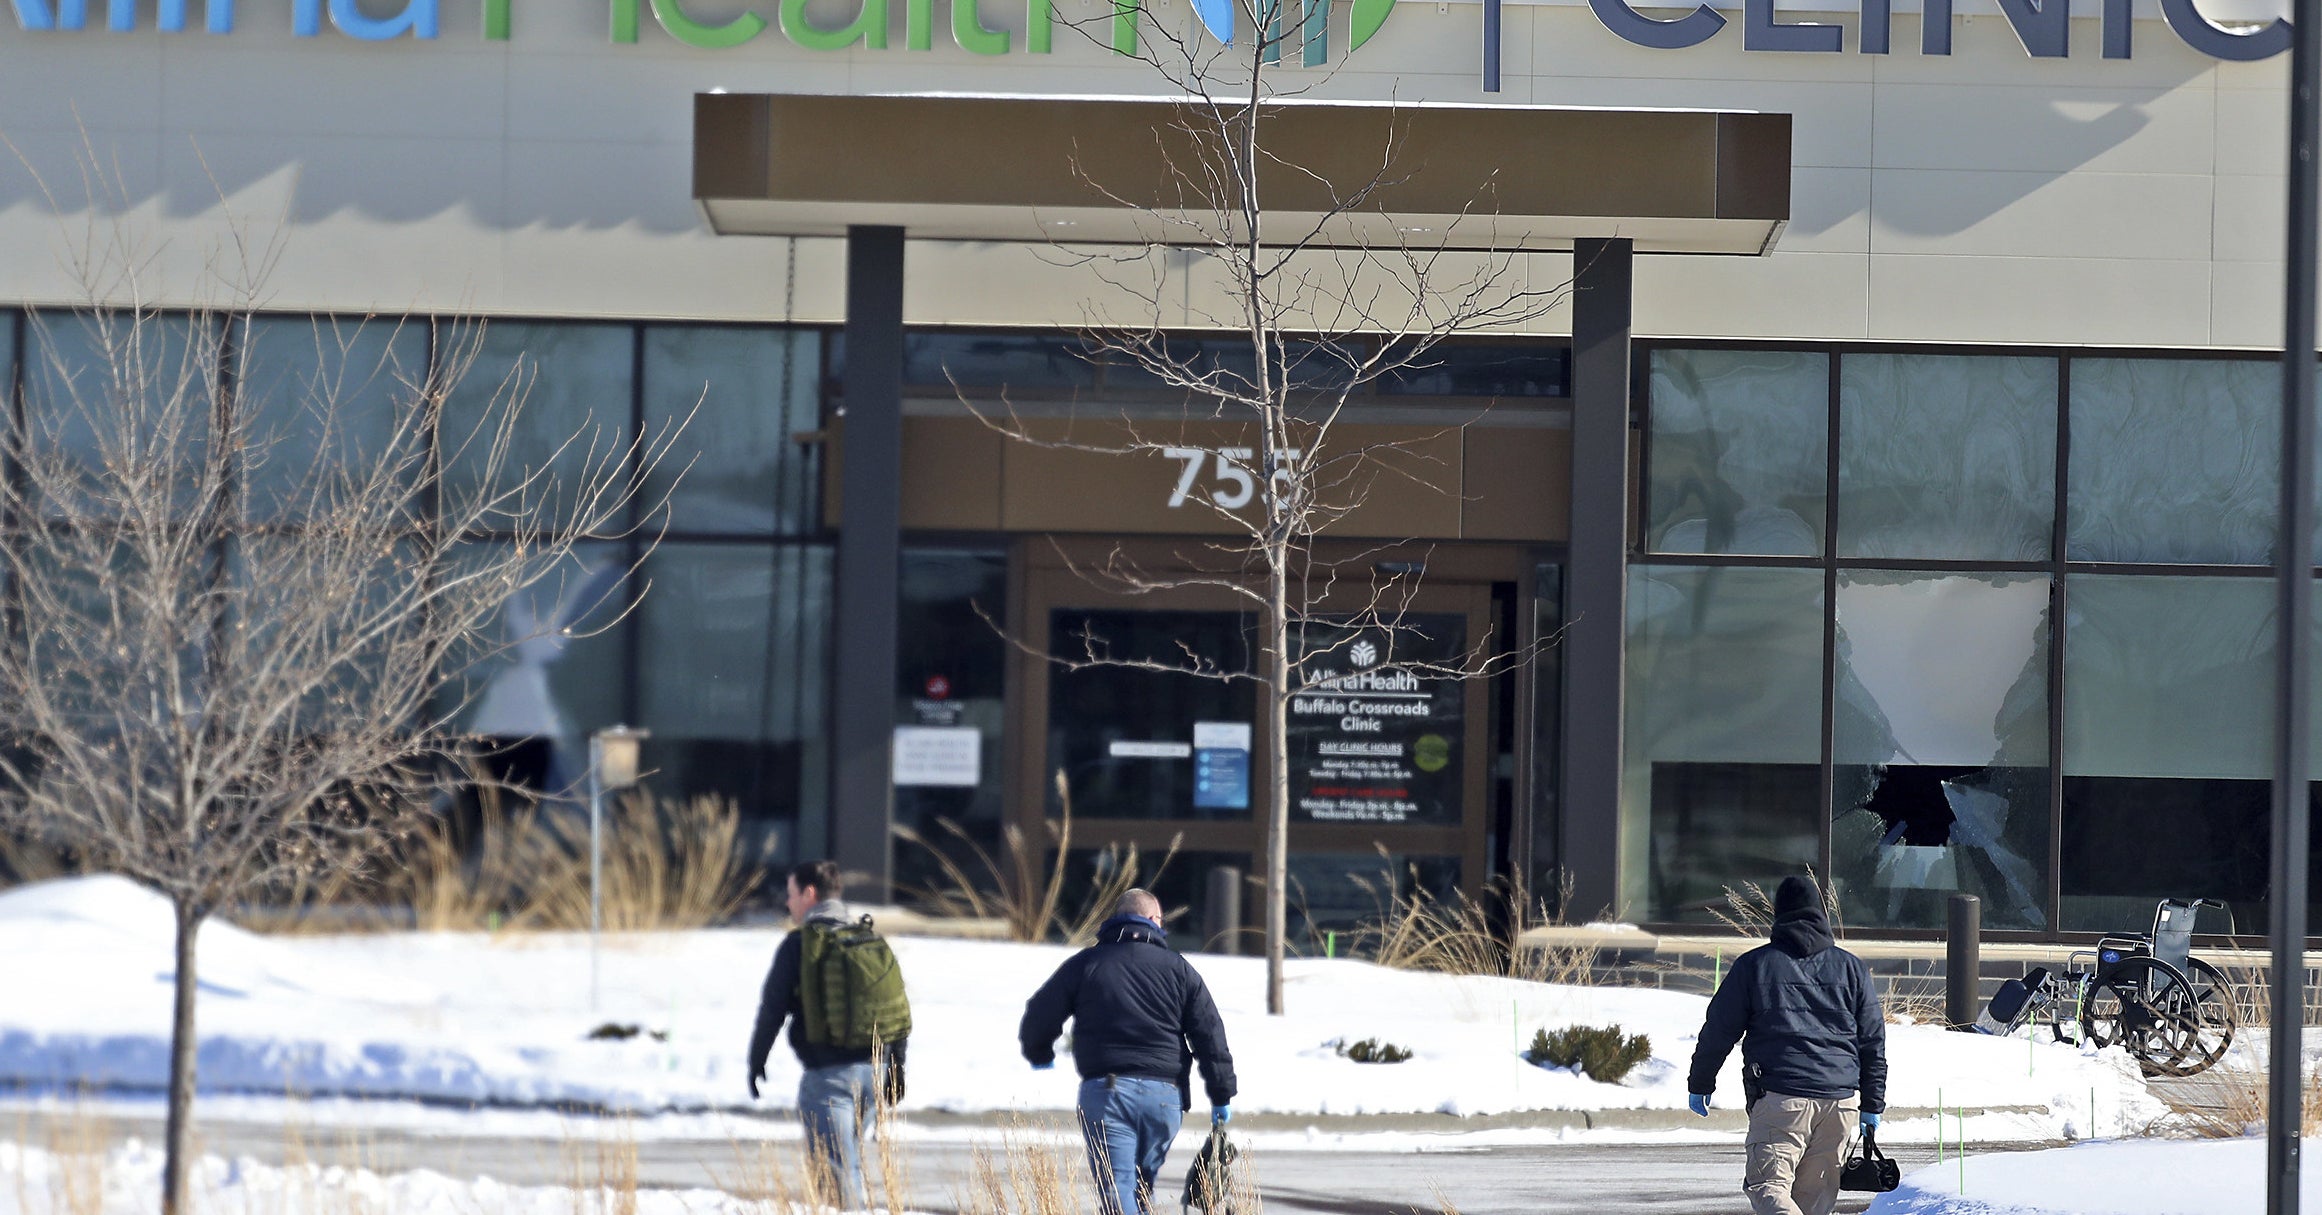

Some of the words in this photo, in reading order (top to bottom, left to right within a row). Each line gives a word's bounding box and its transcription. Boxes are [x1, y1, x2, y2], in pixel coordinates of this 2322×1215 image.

[1360, 671, 1418, 690] Health
[1294, 698, 1345, 715] Buffalo
[1348, 700, 1430, 716] Crossroads
[1341, 716, 1381, 732] Clinic
